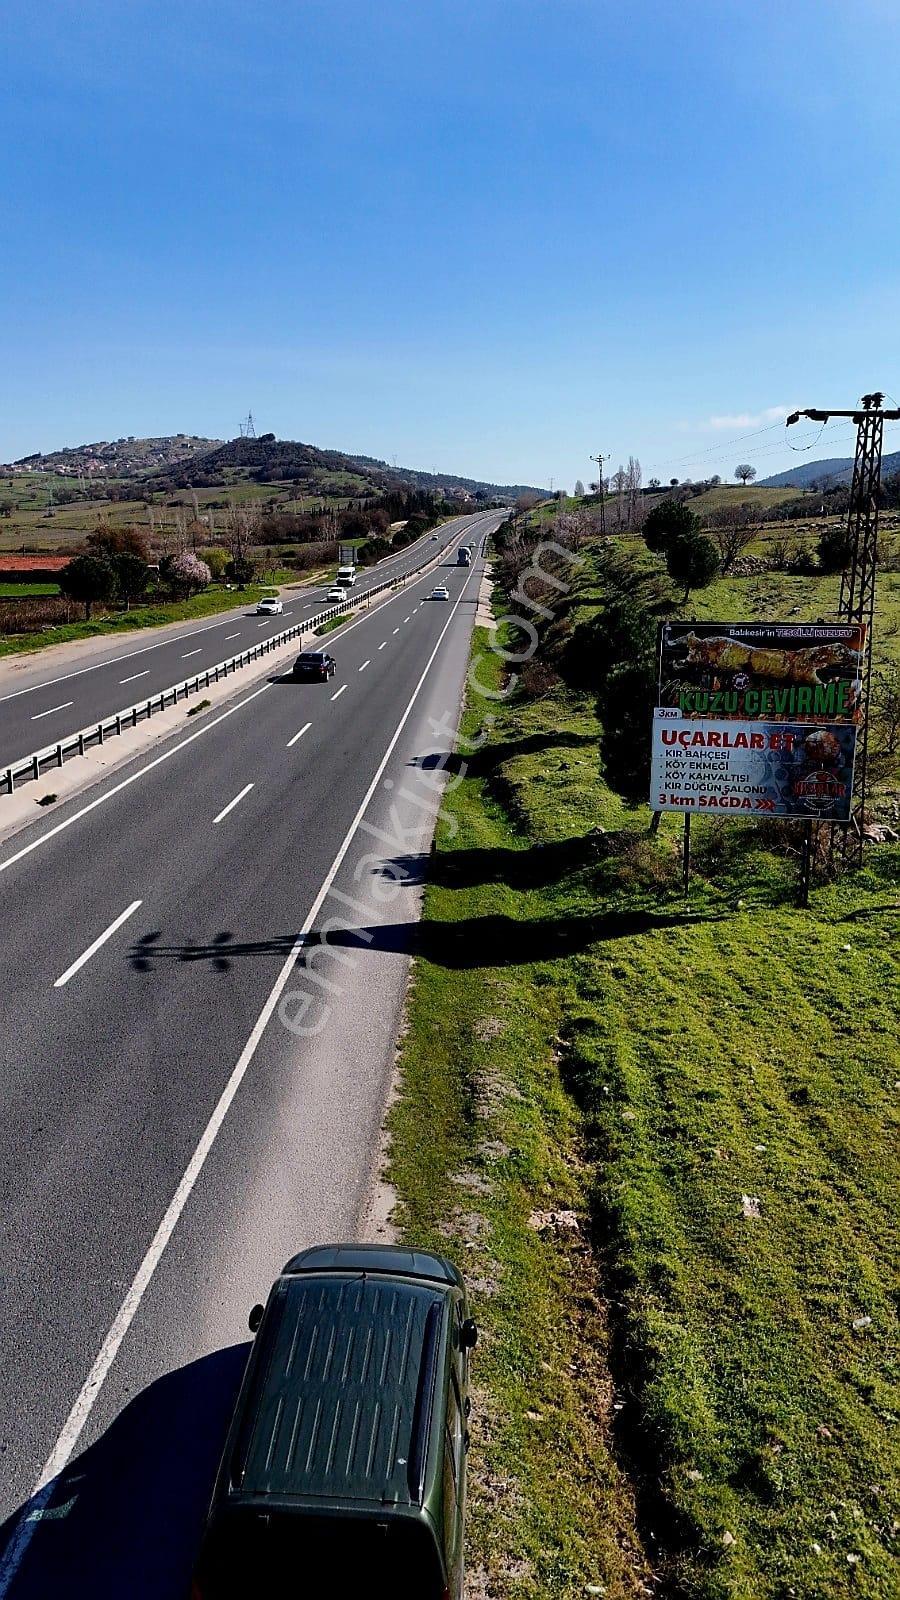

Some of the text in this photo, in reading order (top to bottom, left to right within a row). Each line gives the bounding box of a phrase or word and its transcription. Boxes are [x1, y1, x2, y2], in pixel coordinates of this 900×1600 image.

[679, 689, 738, 713] KUZU
[744, 680, 850, 716] ÇEVİRME
[661, 730, 795, 751] UÇARLAR ET
[665, 749, 730, 760] KIR BAHÇESİ
[665, 760, 729, 771] KÖY EKMEĞİ
[665, 771, 749, 783] KÖY KAHVALTISI
[664, 782, 681, 790] KIR
[684, 783, 721, 792] DÜĞÜN
[659, 794, 667, 805] 3
[670, 794, 695, 806] km
